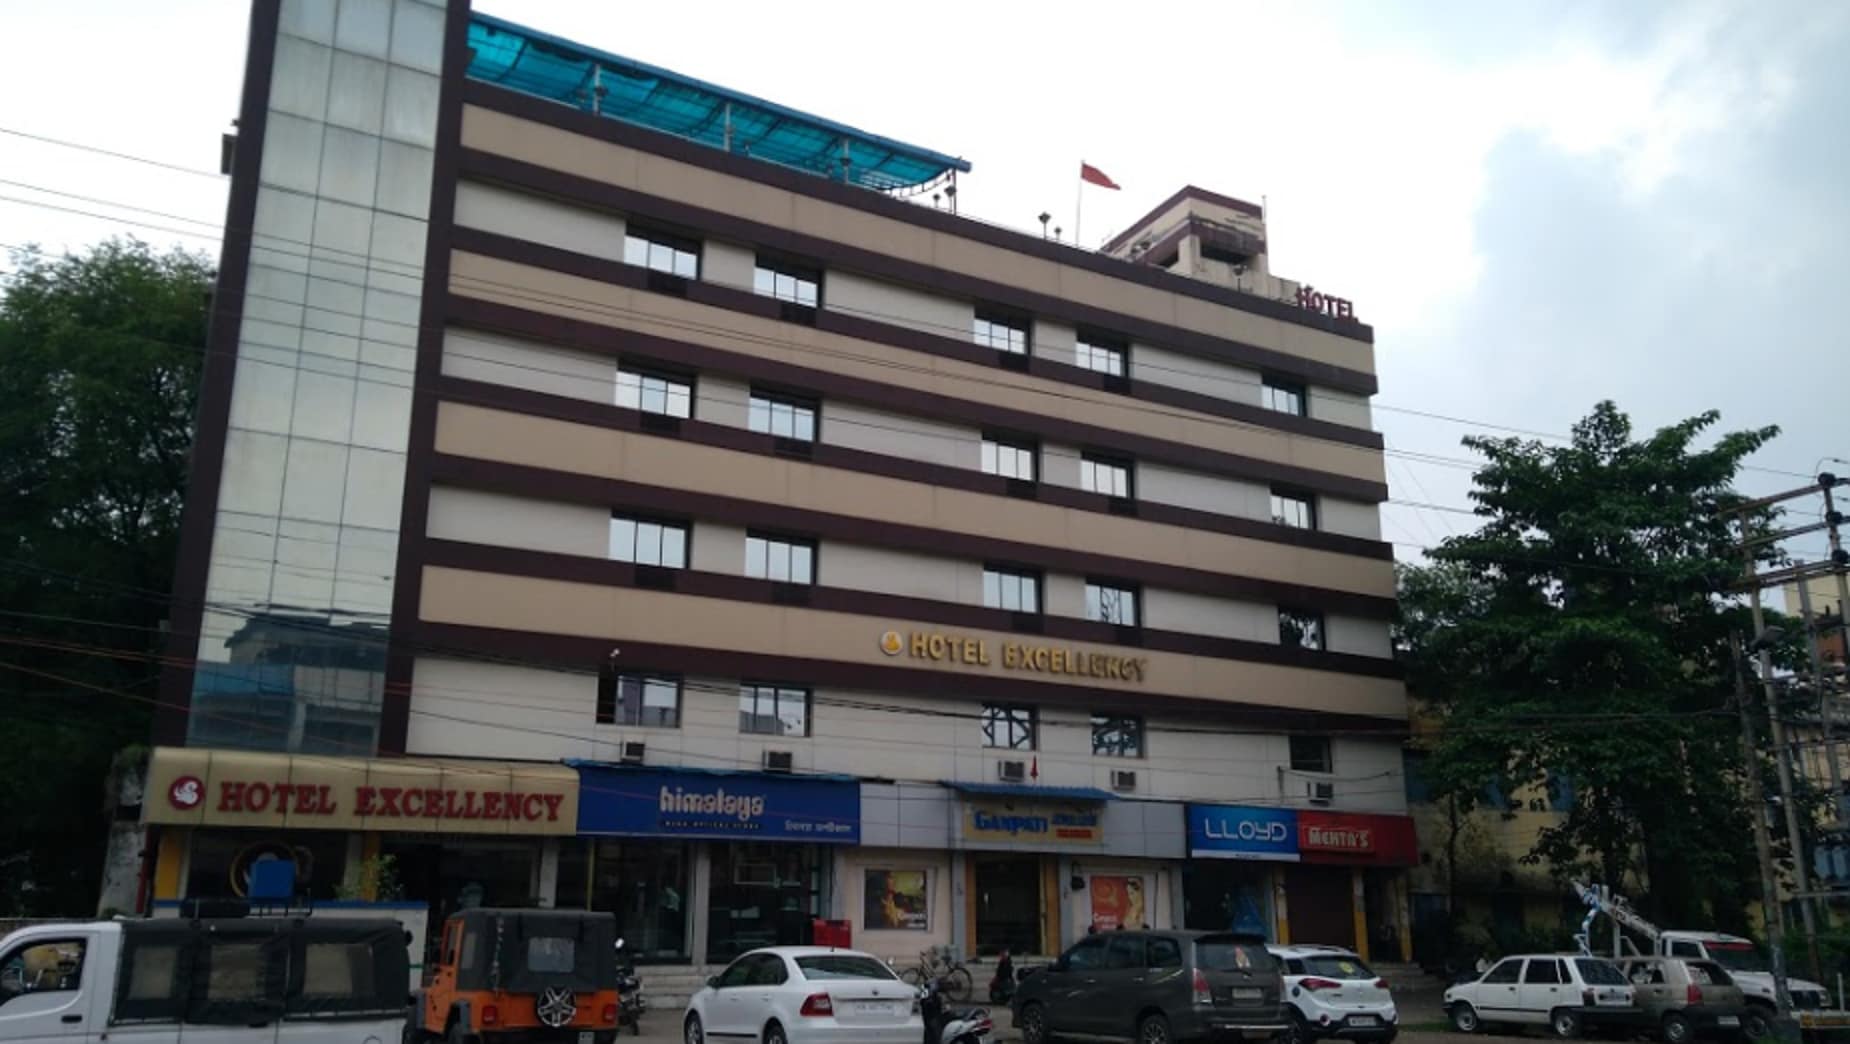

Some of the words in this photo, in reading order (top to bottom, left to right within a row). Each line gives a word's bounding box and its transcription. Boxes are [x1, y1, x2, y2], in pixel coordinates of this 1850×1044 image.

[1295, 284, 1359, 323] HOTEL
[910, 631, 990, 667] HOTEL
[1001, 642, 1147, 682] EXCELLENCY
[216, 781, 338, 815] HOTEL
[353, 786, 565, 822] EXCELLENCY
[659, 785, 765, 821] himalaya
[1205, 817, 1288, 842] LLOYD
[1308, 827, 1370, 848] MEHTA'S
